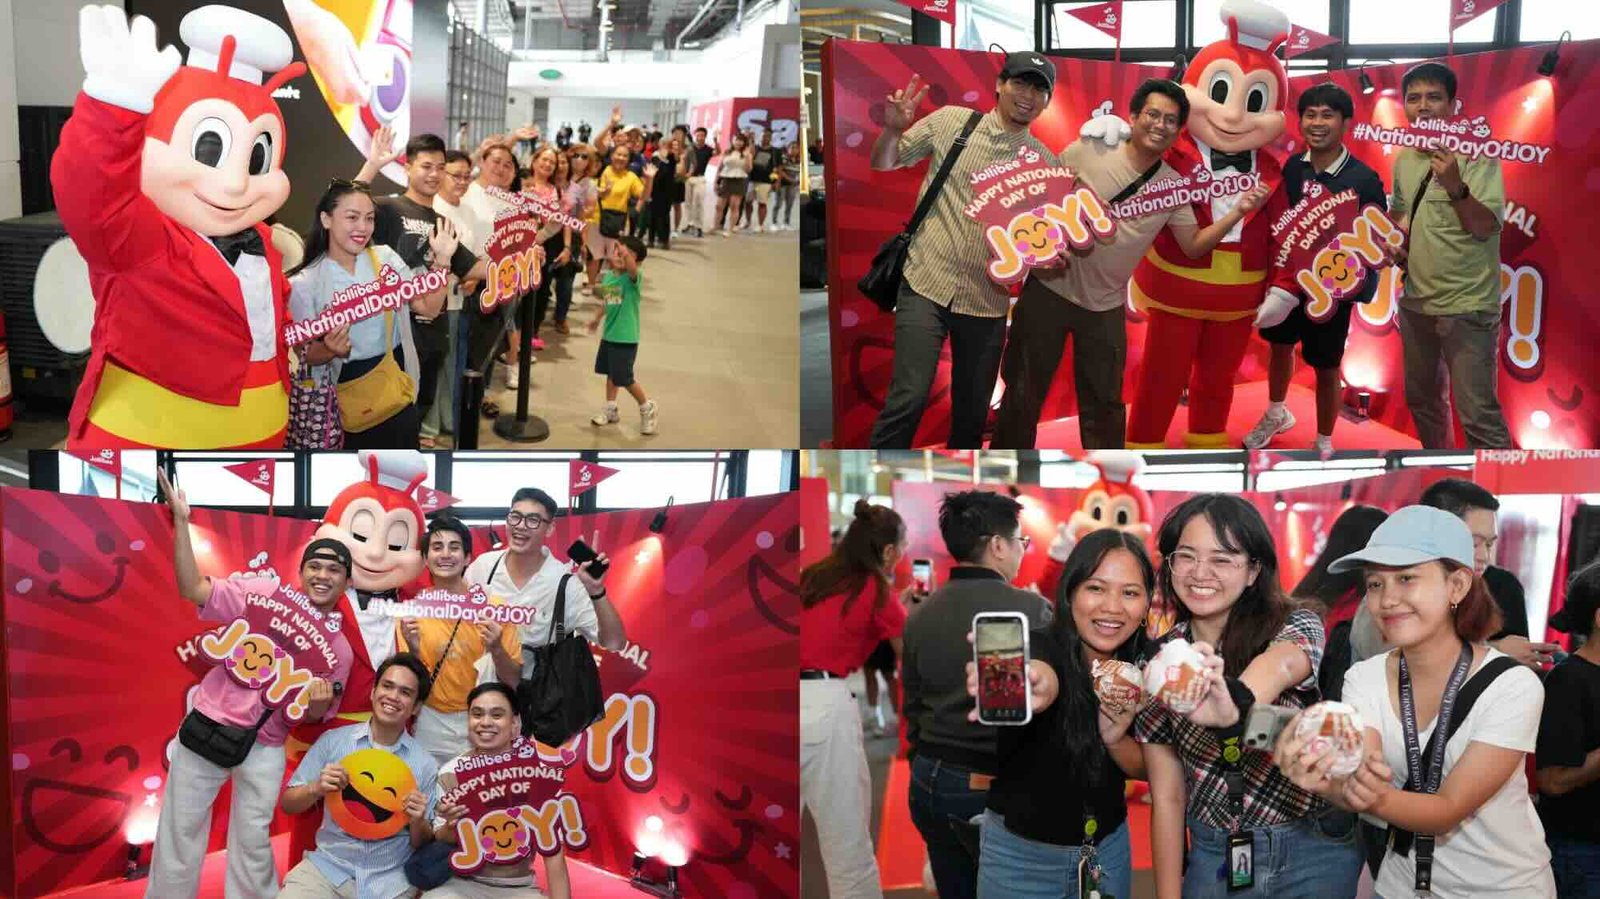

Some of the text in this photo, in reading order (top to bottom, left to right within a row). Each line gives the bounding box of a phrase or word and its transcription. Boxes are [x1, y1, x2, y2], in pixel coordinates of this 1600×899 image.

[1410, 116, 1467, 135] Jollibee
[970, 159, 1021, 185] Jollibee
[1143, 177, 1192, 196] Jollibee
[964, 166, 1074, 218] HAPPY NATIONAL
[1000, 182, 1047, 209] DAY OF
[1110, 172, 1262, 219] NationalDayOfJOY
[986, 188, 1112, 279] JOY!
[1270, 196, 1309, 237] Jollibee
[1274, 189, 1358, 268] HAPPY NATIONAL
[1300, 213, 1337, 250] DAY OF
[1296, 205, 1404, 318] JOY!
[284, 268, 449, 346] #NationalDayOfJOY
[333, 281, 381, 307] Jollibee
[1480, 450, 1529, 465] Happy
[279, 583, 323, 621] Jollibee
[417, 589, 466, 603] Jollibee
[246, 593, 339, 669] HAPPY NATIONAL
[269, 616, 312, 652] DAY OF
[455, 752, 512, 773] Jollibee
[1409, 746, 1422, 792] UNIVERSITY
[442, 766, 564, 806] HAPPY NATIONAL
[478, 781, 531, 804] DAY OF
[451, 794, 587, 870] JOY!
